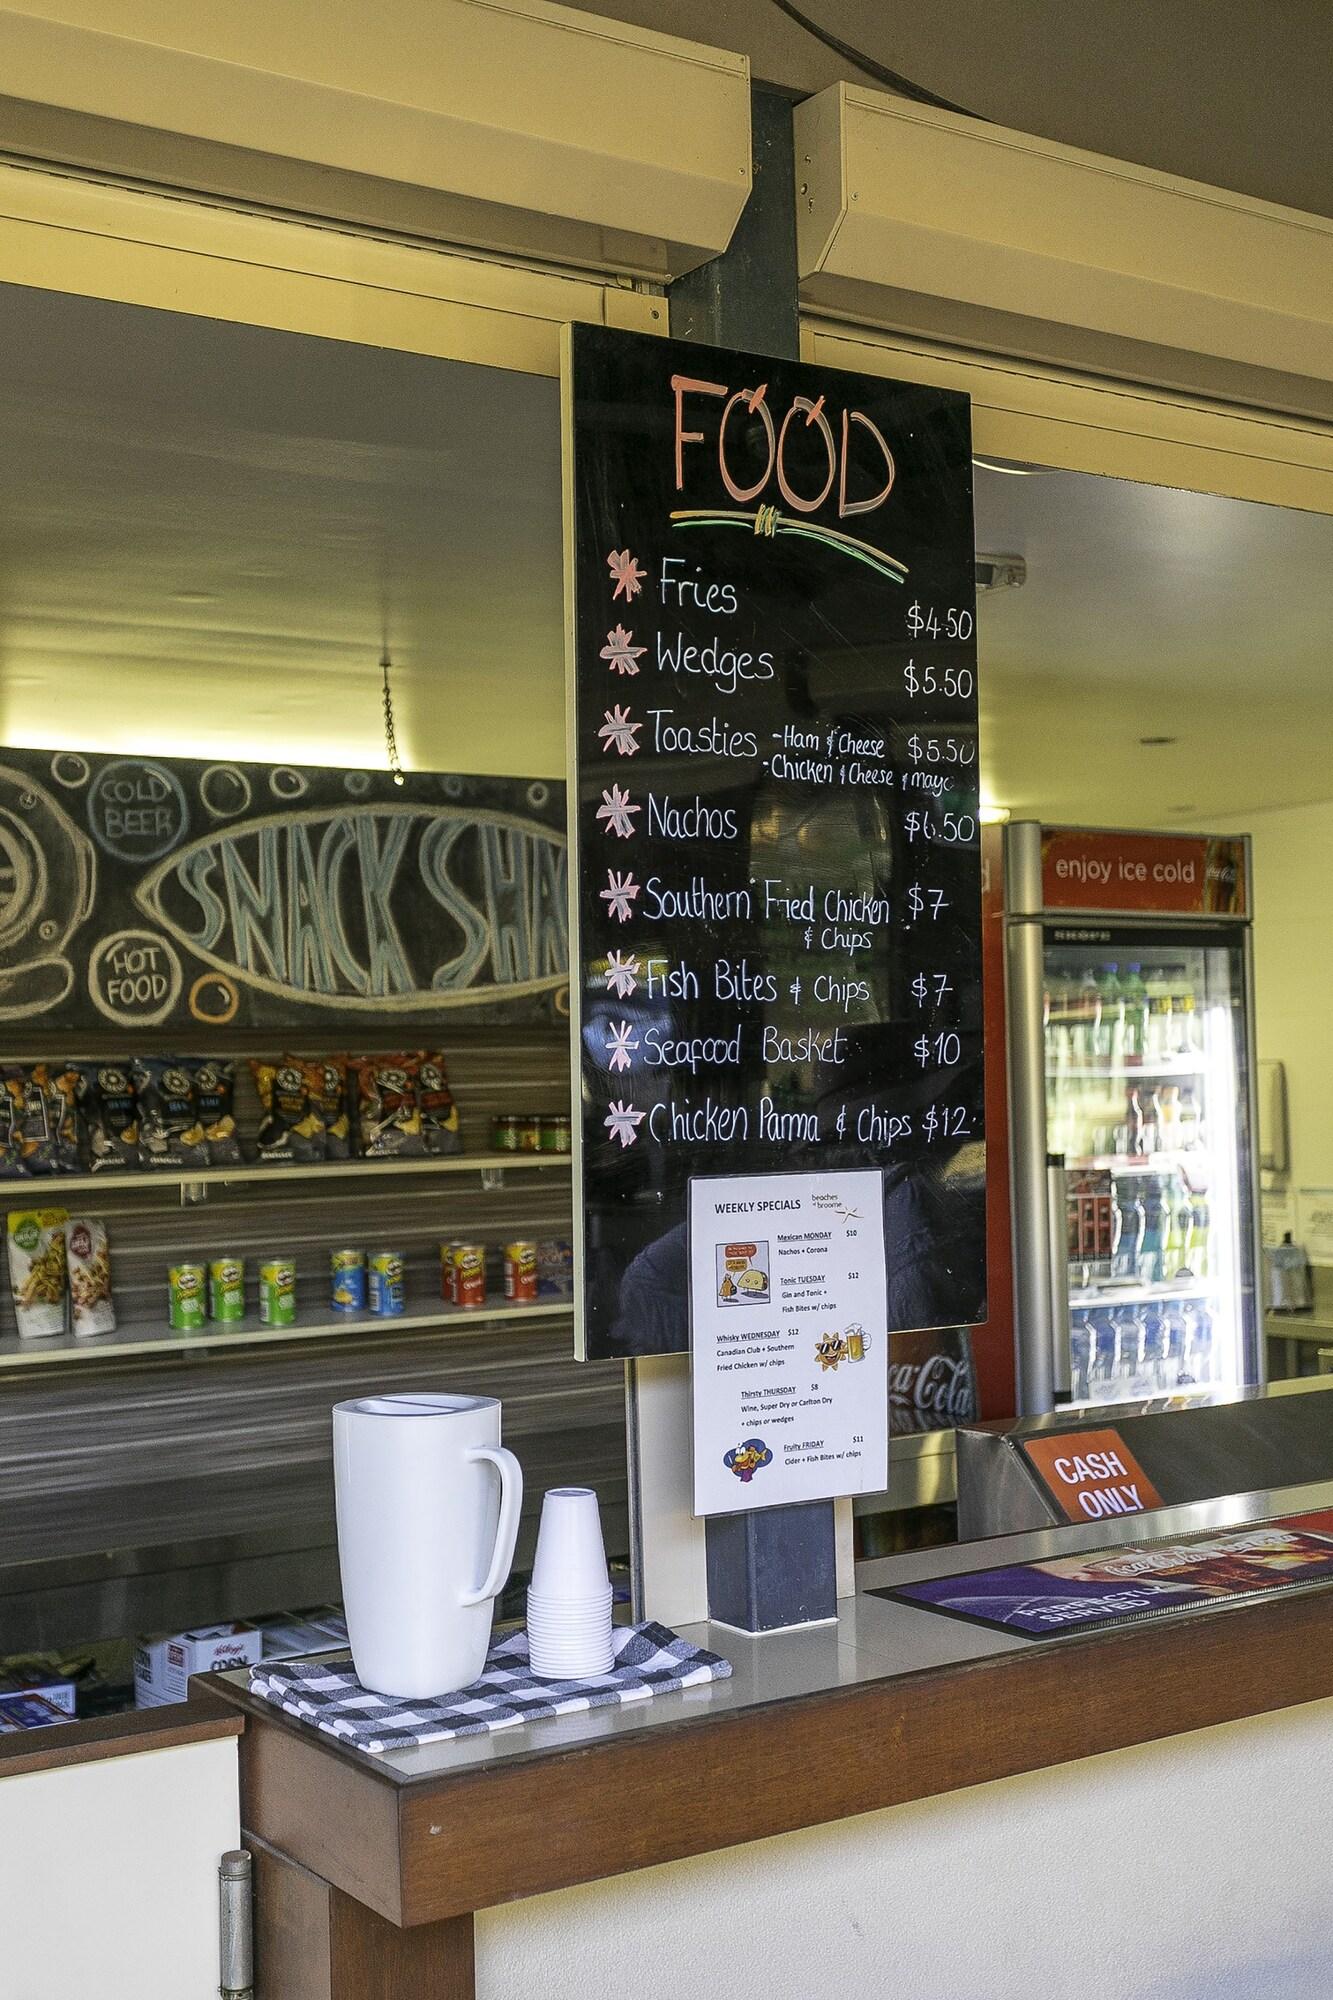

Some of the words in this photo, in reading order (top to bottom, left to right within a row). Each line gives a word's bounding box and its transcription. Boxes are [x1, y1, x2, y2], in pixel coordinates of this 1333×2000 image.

[670, 373, 896, 518] FOOD
[660, 557, 738, 614] Fries
[906, 599, 973, 641] $4.50
[656, 631, 775, 694] Wedges
[904, 658, 973, 699] $5.50
[646, 708, 758, 758] Toasties
[838, 733, 886, 759] Cheese
[907, 733, 975, 765] $5.50
[848, 762, 894, 786] Cheese
[101, 778, 168, 803] COLD
[104, 806, 174, 838] BEER
[647, 792, 738, 840] Nachos
[904, 811, 975, 843] $6.50
[1055, 855, 1112, 885] enjoy
[1118, 856, 1147, 881] ice
[1152, 859, 1195, 884] cold
[177, 814, 416, 998] SNACK
[643, 877, 751, 921] Southern
[764, 879, 814, 923] Fried
[824, 889, 890, 925] Chicken
[908, 882, 951, 921] $7
[821, 927, 873, 956] Chips
[112, 946, 162, 973] HOT
[107, 974, 168, 1004] FOOD
[645, 959, 699, 1001] Fish
[714, 959, 777, 1003] Bites
[813, 975, 870, 1013] Chips
[911, 973, 954, 1007] $7
[643, 1024, 742, 1074] Seafood
[762, 1026, 848, 1064] Basket
[914, 1033, 961, 1067] $10
[649, 1098, 748, 1143] Chicken
[760, 1096, 821, 1143] Parma
[857, 1104, 913, 1143] Chips
[921, 1105, 972, 1143] $12
[714, 1202, 755, 1214] WEEKLY
[757, 1199, 801, 1212] SPECIALS
[811, 1193, 838, 1201] beaches
[777, 1233, 803, 1241] Mexican
[804, 1231, 832, 1240] MONDAY
[846, 1229, 858, 1238] $10
[778, 1247, 800, 1256] Nachos
[806, 1246, 828, 1254] Corona
[780, 1276, 796, 1285] Tonic
[797, 1274, 826, 1283] TUESDAY
[848, 1271, 859, 1280] $12
[782, 1291, 792, 1299] Gin
[793, 1290, 805, 1298] and
[806, 1289, 822, 1297] Tonic
[782, 1305, 794, 1313] Fish
[796, 1304, 810, 1312] Bites
[811, 1303, 820, 1311] w/
[821, 1302, 837, 1310] chips
[716, 1334, 740, 1342] Whisky
[740, 1330, 780, 1341] WEDNESDAY
[788, 1328, 799, 1336] $12
[716, 1348, 745, 1357] Canadian
[746, 1346, 760, 1354] Club
[766, 1344, 795, 1353] Southern
[716, 1364, 733, 1372] Fried
[734, 1361, 758, 1370] Chicken
[759, 1359, 768, 1368] w/
[769, 1358, 785, 1367] chips
[740, 1404, 759, 1412] Wine,
[760, 1402, 778, 1411] Super
[779, 1401, 790, 1409] Dry
[799, 1398, 821, 1407] Carlton
[821, 1396, 833, 1405] Dry
[741, 1390, 762, 1399] Thirsty
[763, 1386, 797, 1396] THURSDAY
[811, 1383, 819, 1392] $8
[746, 1418, 762, 1427] chips
[763, 1417, 770, 1425] or
[771, 1415, 794, 1424] wedges
[783, 1443, 801, 1452] Fruity
[802, 1439, 825, 1449] FRIDAY
[852, 1435, 864, 1444] $11
[784, 1457, 801, 1466] Cider
[806, 1454, 819, 1463] Fish
[819, 1453, 835, 1461] Bites
[836, 1451, 845, 1459] w/
[845, 1450, 862, 1459] chips
[1053, 1450, 1128, 1485] CASH
[1077, 1484, 1145, 1519] ONLY
[1103, 1549, 1208, 1577] Coca-Cola
[1017, 1585, 1170, 1617] PERFECTLY
[1039, 1599, 1151, 1623] SERVED
